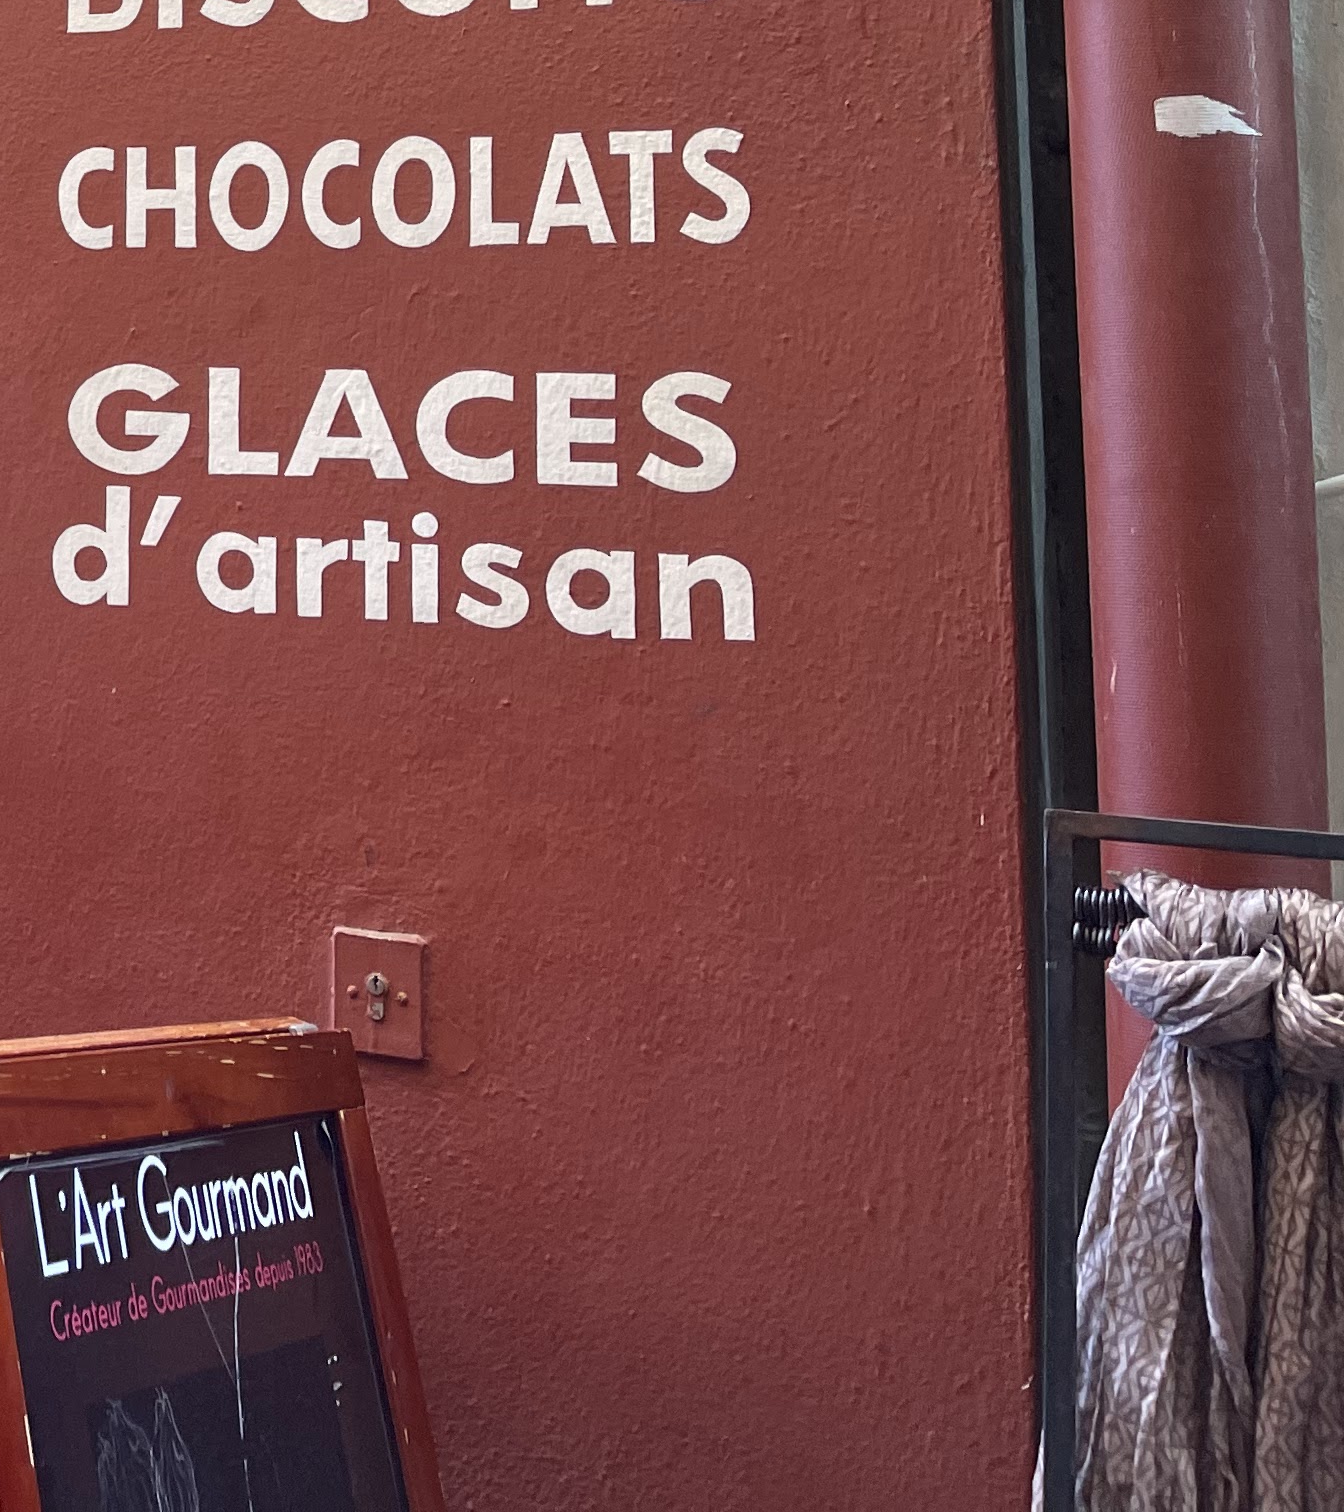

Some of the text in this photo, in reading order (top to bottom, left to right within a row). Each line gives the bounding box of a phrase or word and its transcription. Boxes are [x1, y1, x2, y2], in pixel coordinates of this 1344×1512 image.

[56, 126, 753, 252] CHOCOLATS
[66, 362, 739, 494] GLACES
[51, 484, 757, 642] d'artisan
[28, 1130, 315, 1278] L'Art Gourmand
[49, 1240, 324, 1342] Créateur de Gourmandises depuis 1983
